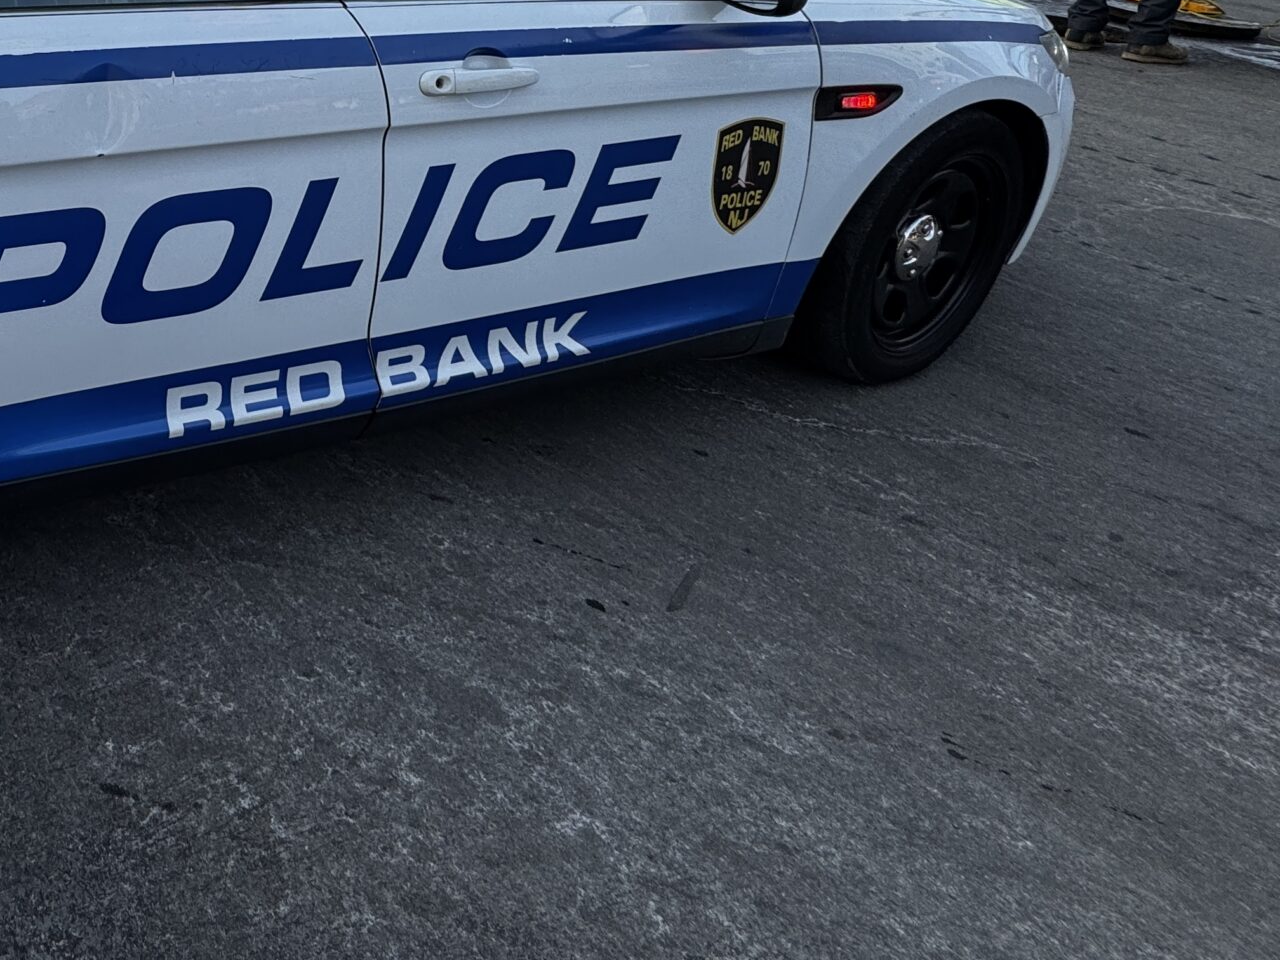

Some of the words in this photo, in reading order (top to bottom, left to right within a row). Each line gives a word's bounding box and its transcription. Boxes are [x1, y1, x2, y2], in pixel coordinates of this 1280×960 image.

[721, 129, 744, 153] RED
[752, 125, 780, 146] BANK
[721, 164, 733, 180] 18
[758, 160, 770, 176] 70
[719, 189, 763, 210] POLICE
[166, 360, 346, 439] RED
[375, 311, 591, 399] BANK
